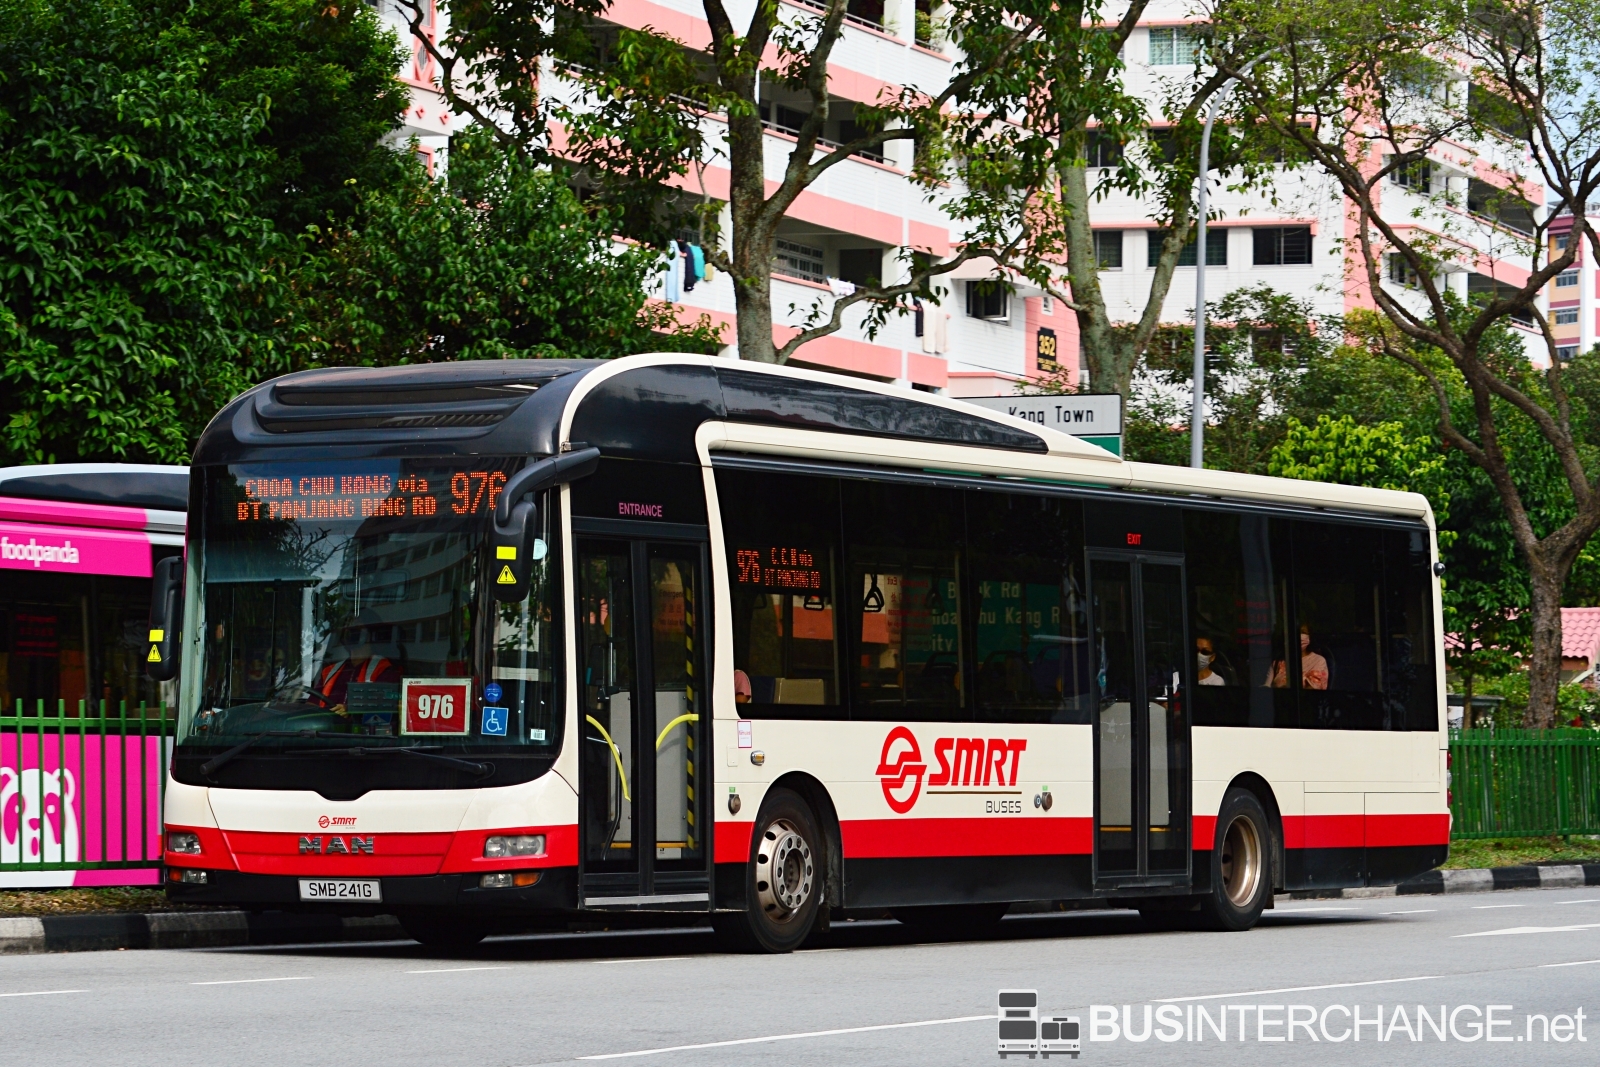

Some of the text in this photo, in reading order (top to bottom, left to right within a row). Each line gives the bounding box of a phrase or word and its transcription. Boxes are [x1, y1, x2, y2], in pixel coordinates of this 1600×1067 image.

[1038, 334, 1055, 356] 352
[1055, 406, 1094, 423] Town
[245, 474, 428, 498] CHOA CHU KANG via
[237, 496, 436, 521] BT PANJANG RING RD
[619, 502, 662, 517] ENTRANCE
[1127, 533, 1141, 545] EXIT
[1, 537, 80, 567] foodpanda
[737, 550, 760, 583] 976
[1000, 581, 1021, 598] Rd
[978, 607, 996, 624] hu
[418, 694, 454, 719] 976
[928, 737, 1027, 786] SMRT
[985, 800, 1022, 814] BUSES
[330, 816, 358, 825] SMRT
[299, 836, 375, 854] MAN
[308, 882, 373, 898] SMB241G
